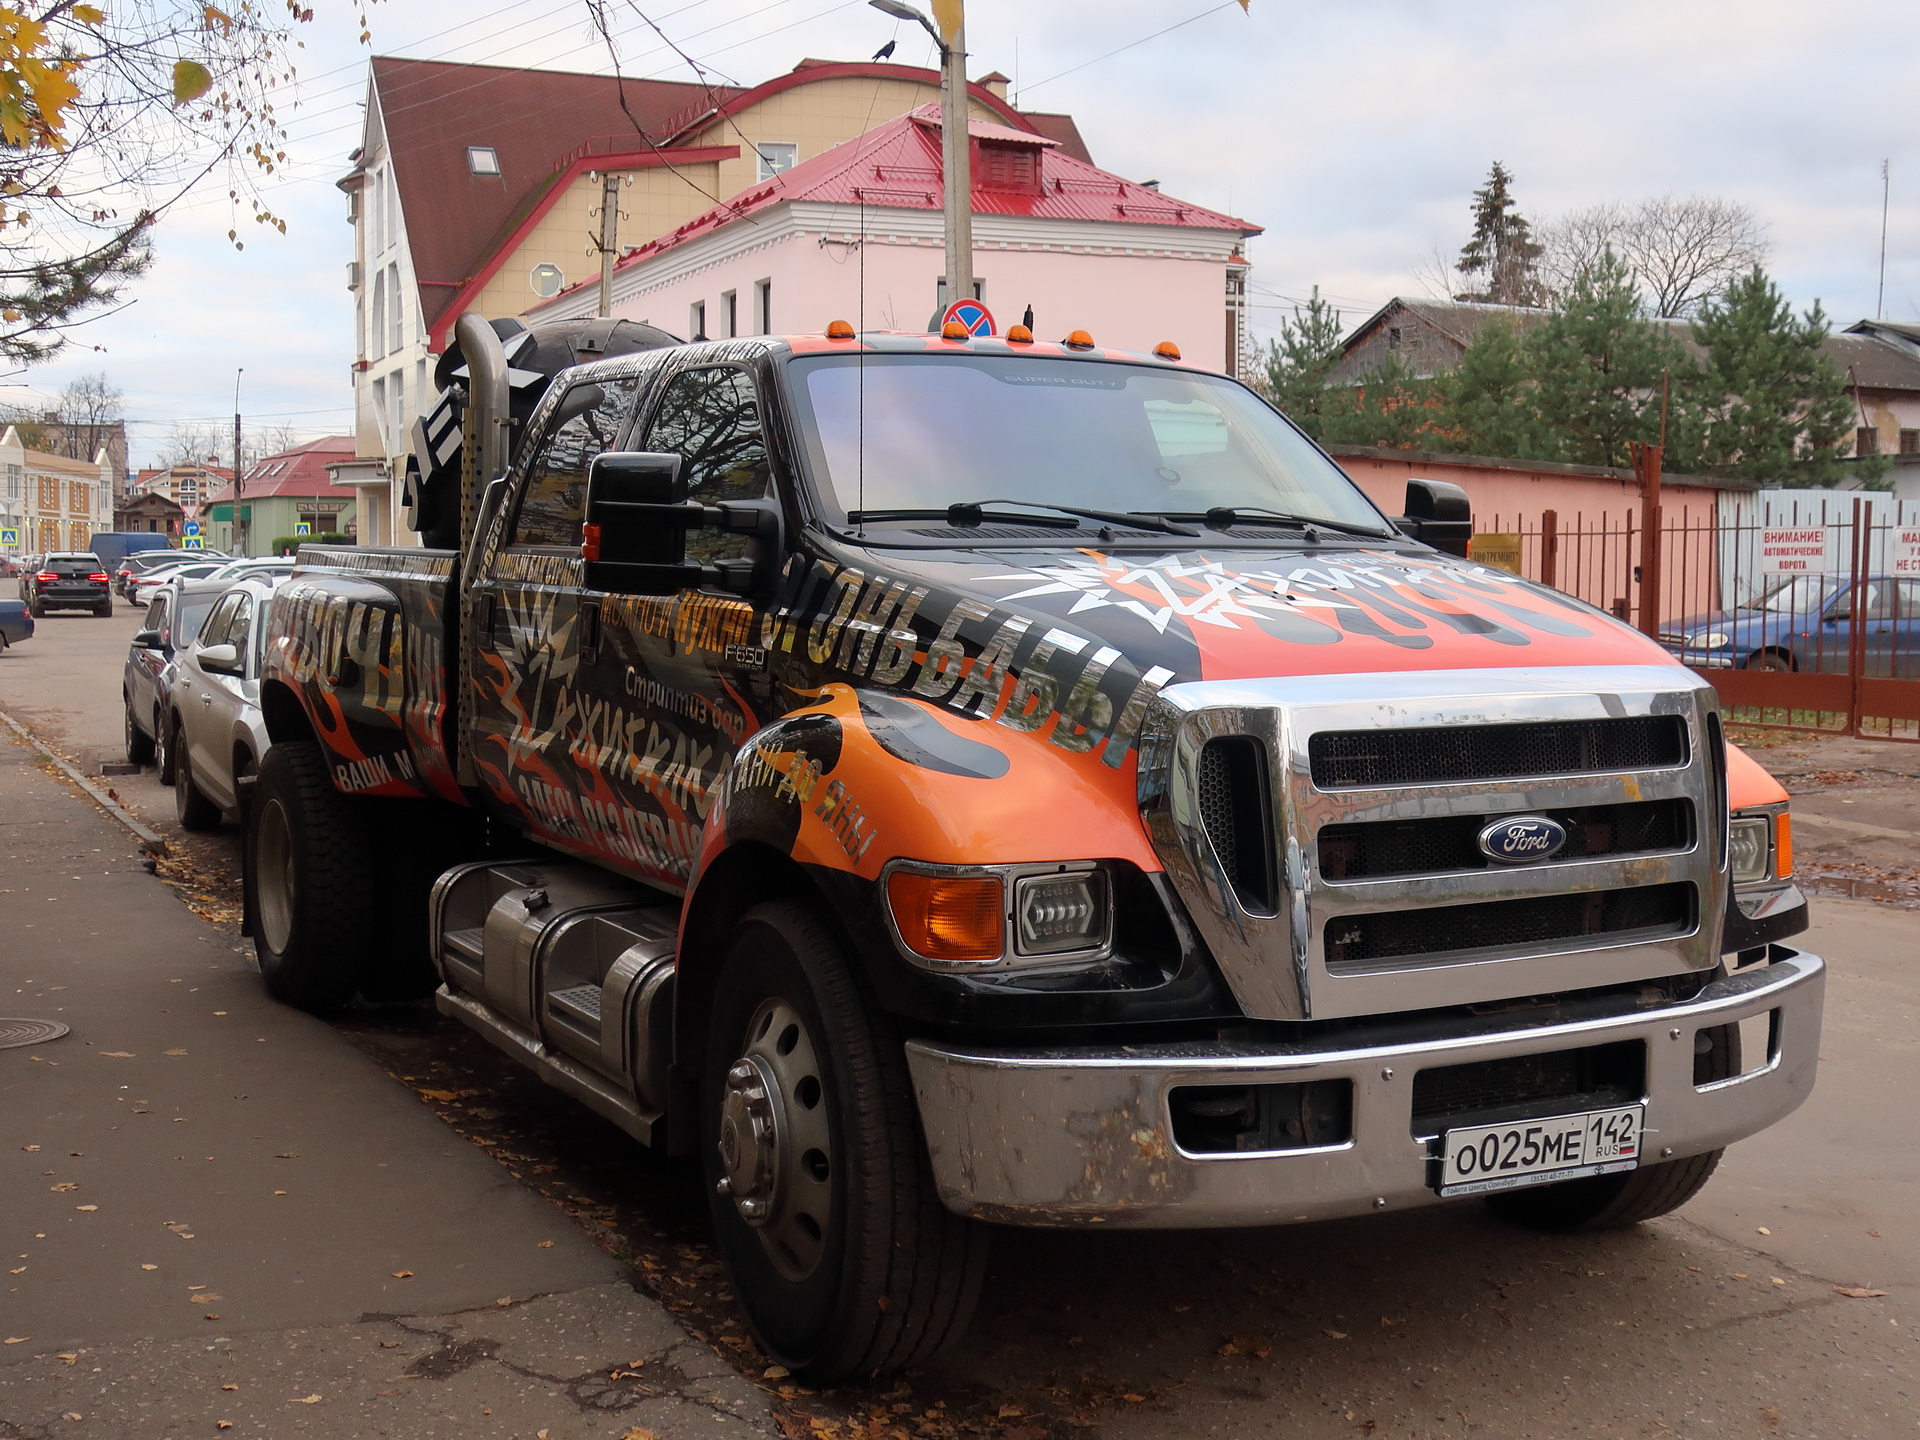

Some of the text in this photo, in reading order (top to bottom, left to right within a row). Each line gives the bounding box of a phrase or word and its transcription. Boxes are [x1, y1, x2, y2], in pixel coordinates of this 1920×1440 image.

[1004, 376, 1116, 387] SUPER DUTY
[1764, 531, 1824, 543] ВНИМАНИЕ!
[1764, 546, 1824, 556] АВТОМАТИЧЕСКИЕ
[1779, 560, 1807, 570] ВОРОТА
[1896, 560, 1909, 570] НЕ
[910, 597, 1176, 770] БАБЫ
[625, 666, 744, 740] Стриптиз бар
[336, 754, 393, 793] ВАШИ
[774, 749, 823, 805] ДО
[814, 779, 878, 867] ЯНЫ
[1503, 825, 1550, 852] Ford
[1456, 1113, 1634, 1175] О025МЕ 142
[1595, 1144, 1619, 1157] RUS
